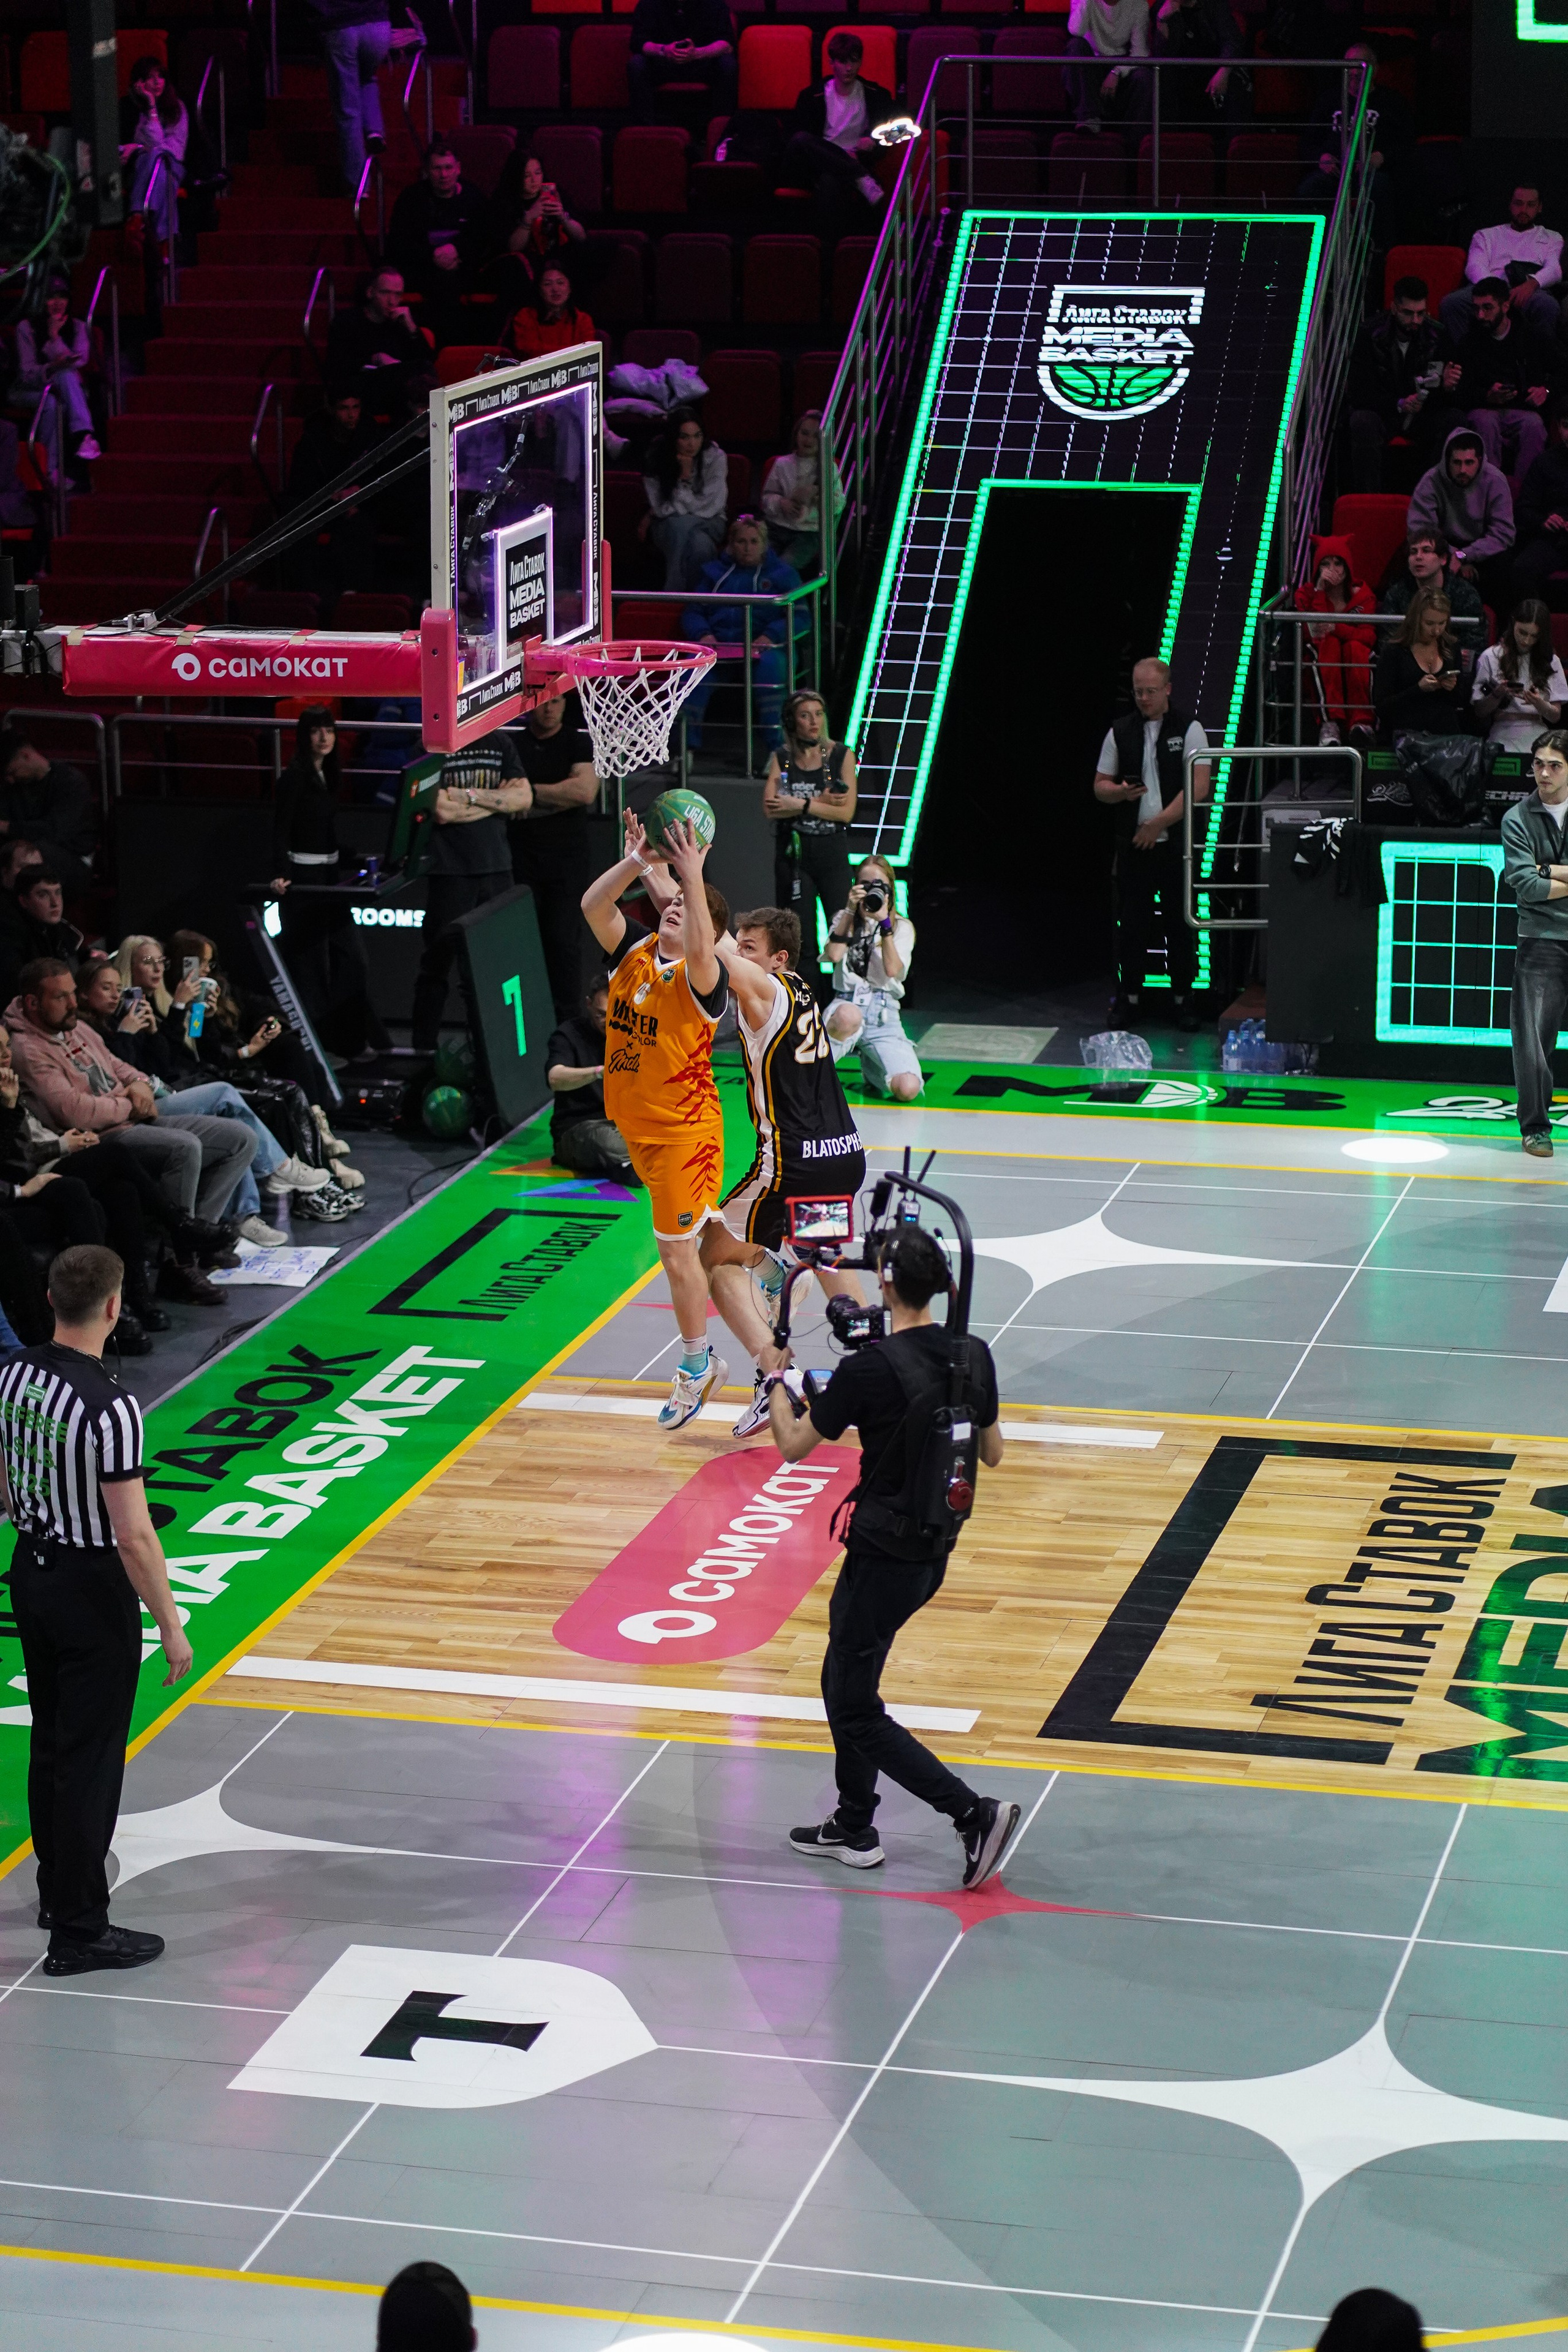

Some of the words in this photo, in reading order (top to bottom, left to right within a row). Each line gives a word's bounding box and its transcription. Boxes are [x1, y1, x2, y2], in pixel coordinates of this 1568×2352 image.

[1042, 326, 1195, 347] MEDIA
[1038, 346, 1194, 364] BASKET
[510, 577, 545, 611] MEDIA
[510, 598, 545, 629] BASKET
[684, 805, 704, 828] LIGA
[143, 1344, 383, 1530] ТАВОК
[187, 1345, 486, 1539] BASKET
[1414, 1484, 1568, 1783] MED
